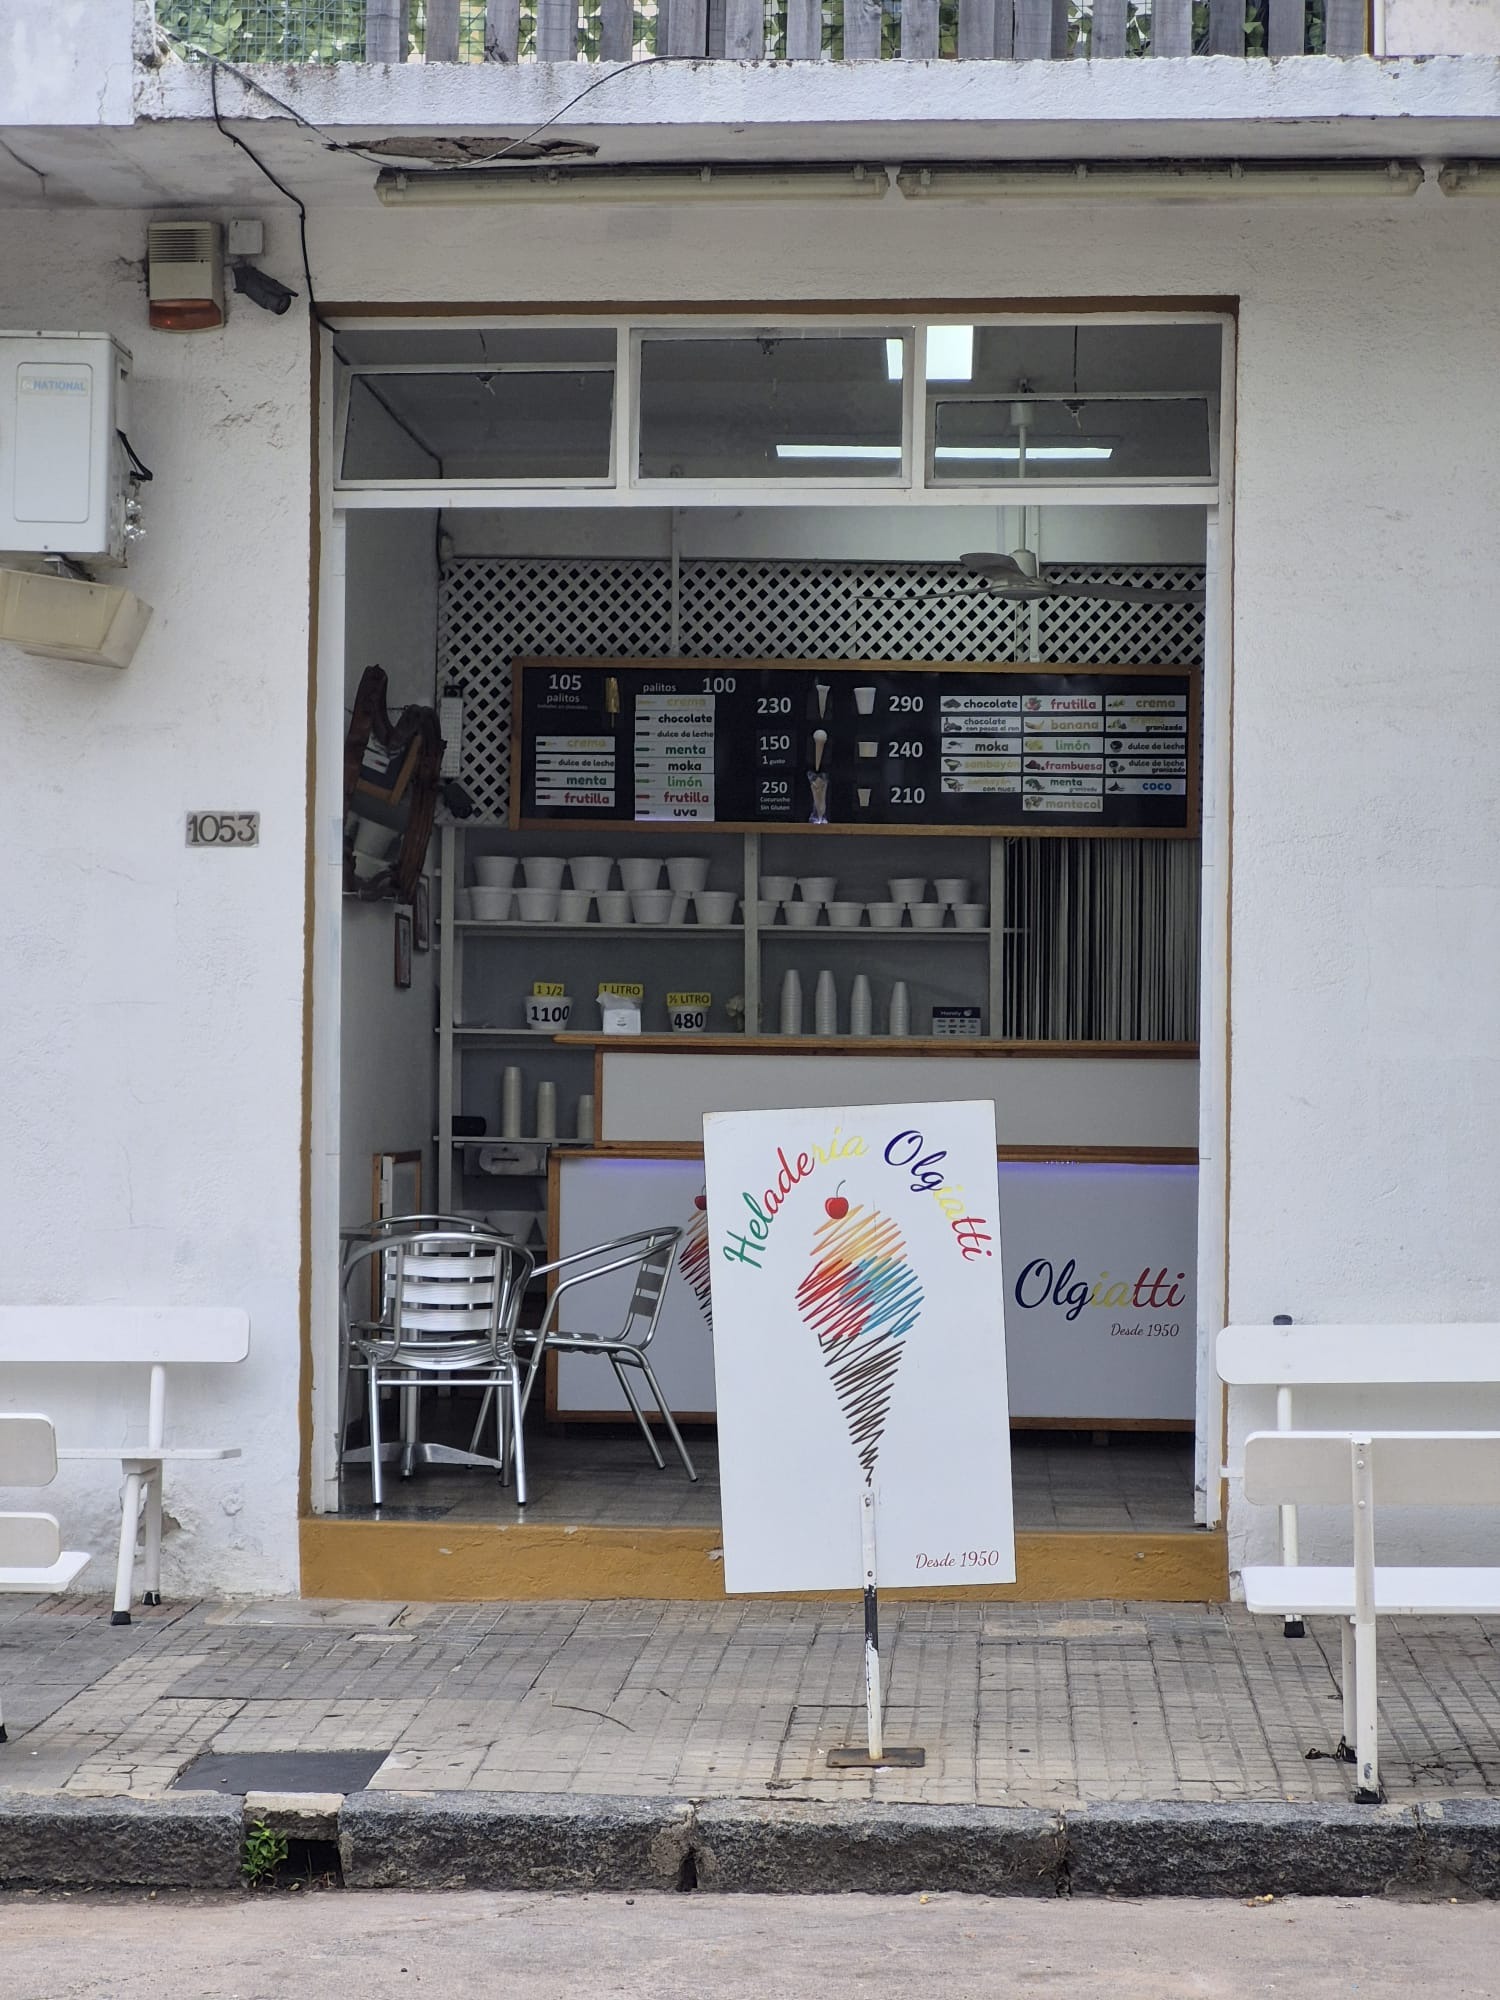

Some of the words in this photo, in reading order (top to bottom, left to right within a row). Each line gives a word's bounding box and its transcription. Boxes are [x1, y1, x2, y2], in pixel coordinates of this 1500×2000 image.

[32, 380, 86, 392] NATIONAL
[548, 673, 582, 691] 105
[643, 682, 677, 693] palitos
[702, 677, 737, 693] 100
[546, 692, 580, 704] palitos
[889, 695, 924, 712] 290
[963, 698, 1018, 709] chocolate
[1050, 698, 1097, 710] frutilla
[1136, 698, 1176, 708] crema
[757, 697, 792, 714] 230
[658, 713, 713, 723] chocolate
[964, 717, 1007, 725] chocolate
[1051, 718, 1099, 730] banana
[657, 729, 679, 738] dulce
[692, 729, 714, 738] leche
[760, 735, 790, 750] 150
[975, 740, 1008, 752] moka
[1055, 739, 1091, 751] limón
[1128, 741, 1150, 750] dulce
[1151, 741, 1161, 750] de
[1163, 741, 1185, 750] leche
[665, 744, 706, 755] menta
[888, 741, 924, 758] 240
[558, 758, 580, 767] dulce
[593, 759, 615, 767] leche
[668, 760, 702, 771] moka
[762, 755, 768, 764] 1
[1045, 760, 1103, 771] frambuesa
[1128, 759, 1150, 767] dulce
[1163, 759, 1185, 767] leche
[567, 775, 607, 785] menta
[667, 775, 703, 788] limón
[1050, 777, 1083, 786] menta
[762, 781, 788, 793] 250
[1142, 782, 1172, 791] coco
[564, 791, 610, 804] frutilla
[664, 791, 709, 803] frutilla
[890, 787, 925, 803] 210
[1046, 798, 1101, 809] mantecol
[673, 807, 698, 817] uva
[188, 814, 256, 843] 1053
[611, 984, 641, 996] LITRO
[680, 994, 710, 1005] LITRO
[531, 1005, 570, 1023] 1100
[674, 1012, 704, 1030] 480
[884, 1130, 993, 1262] Olgiatti
[1015, 1258, 1186, 1321] Olgiatti
[1111, 1323, 1145, 1336] Desde
[1147, 1323, 1180, 1337] 1950
[916, 1552, 956, 1569] Desde
[959, 1550, 1000, 1568] 1950
